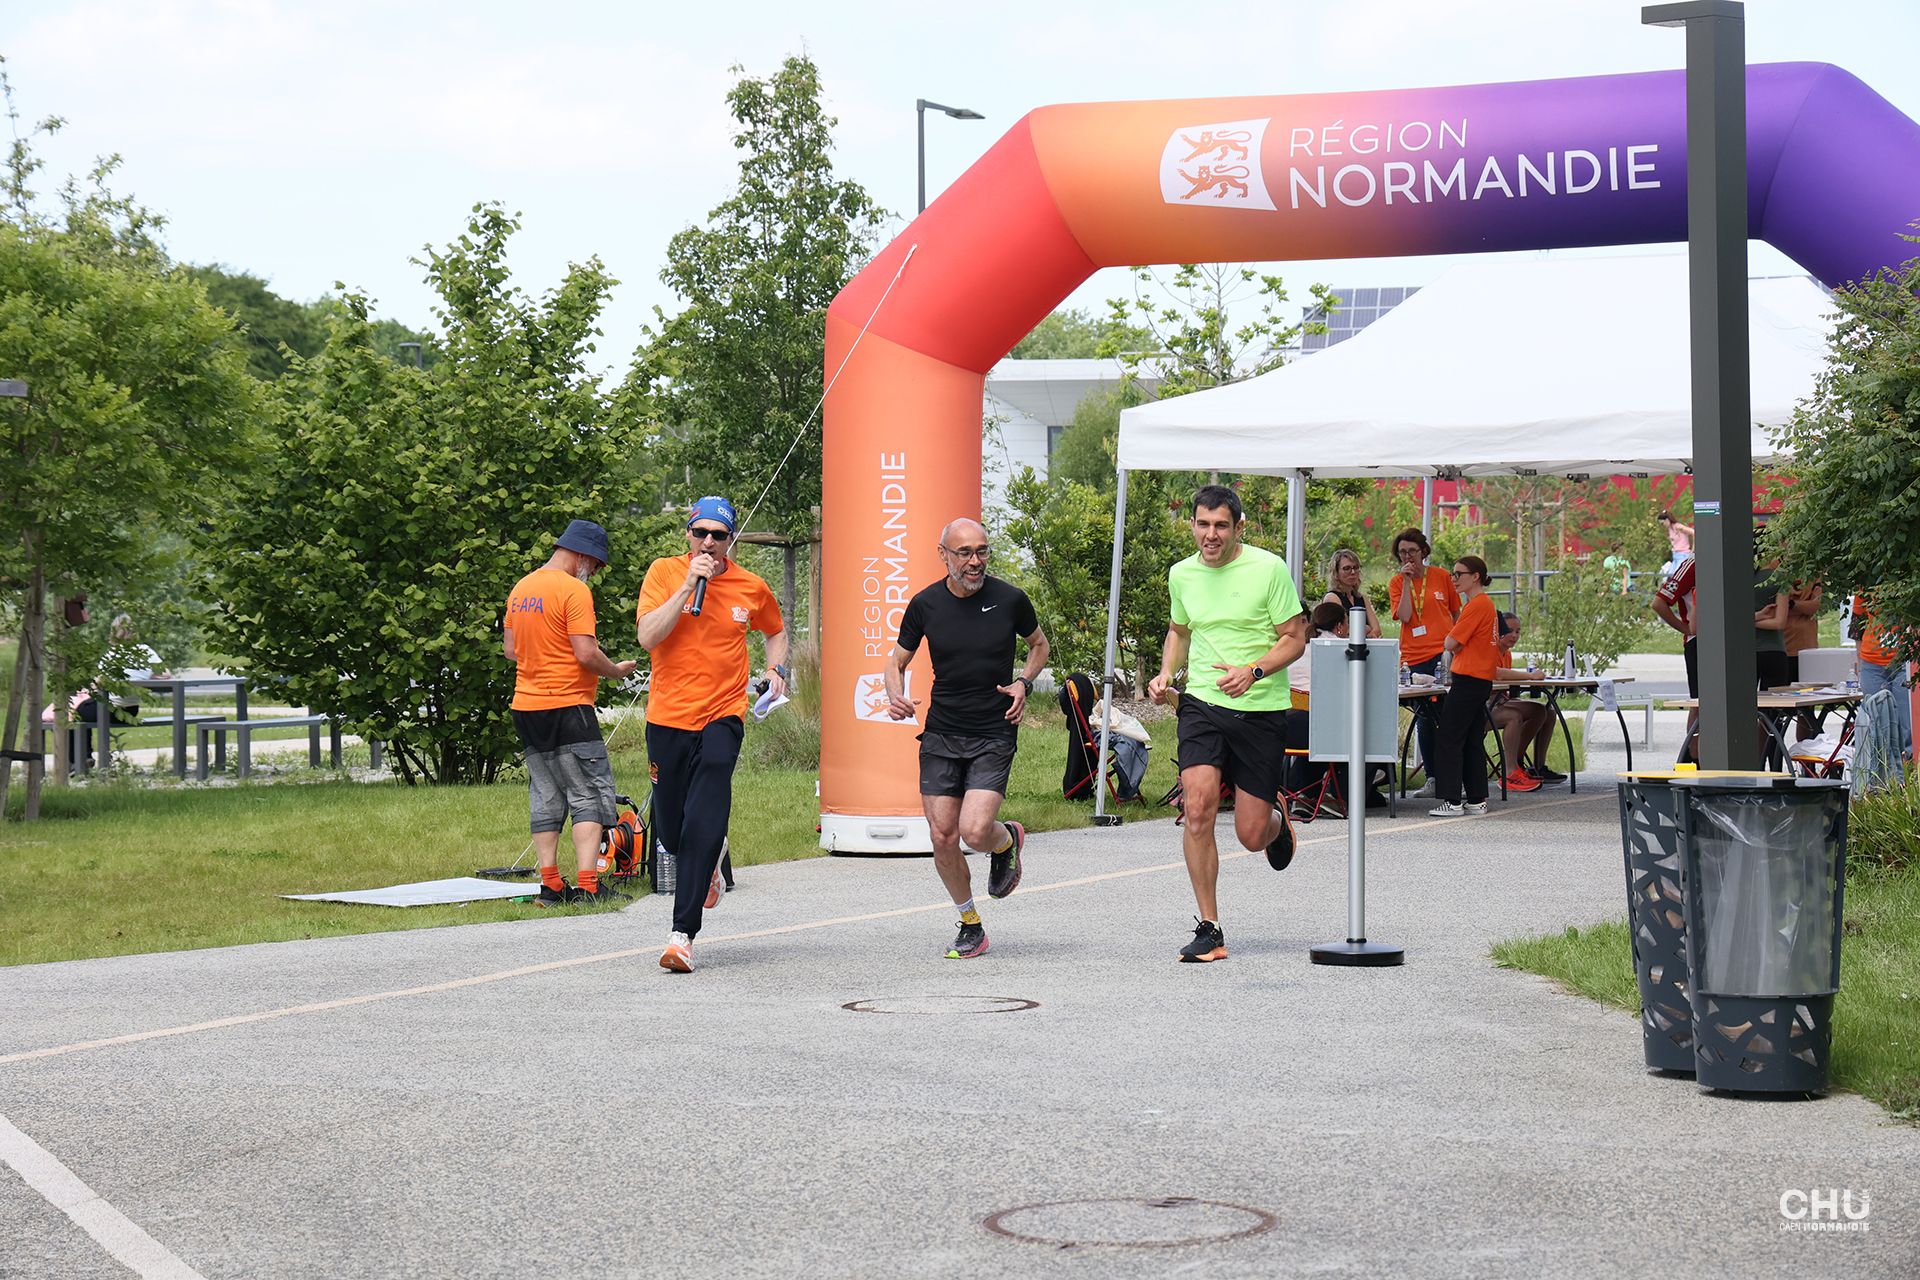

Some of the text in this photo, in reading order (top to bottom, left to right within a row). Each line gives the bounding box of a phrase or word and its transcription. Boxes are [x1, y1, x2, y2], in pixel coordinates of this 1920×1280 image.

[1289, 118, 1468, 158] RÉGION
[1288, 144, 1662, 210] NORMANDIE
[880, 452, 909, 657] ORMANDIE
[511, 596, 544, 614] E-APA
[860, 556, 882, 658] RÉGION
